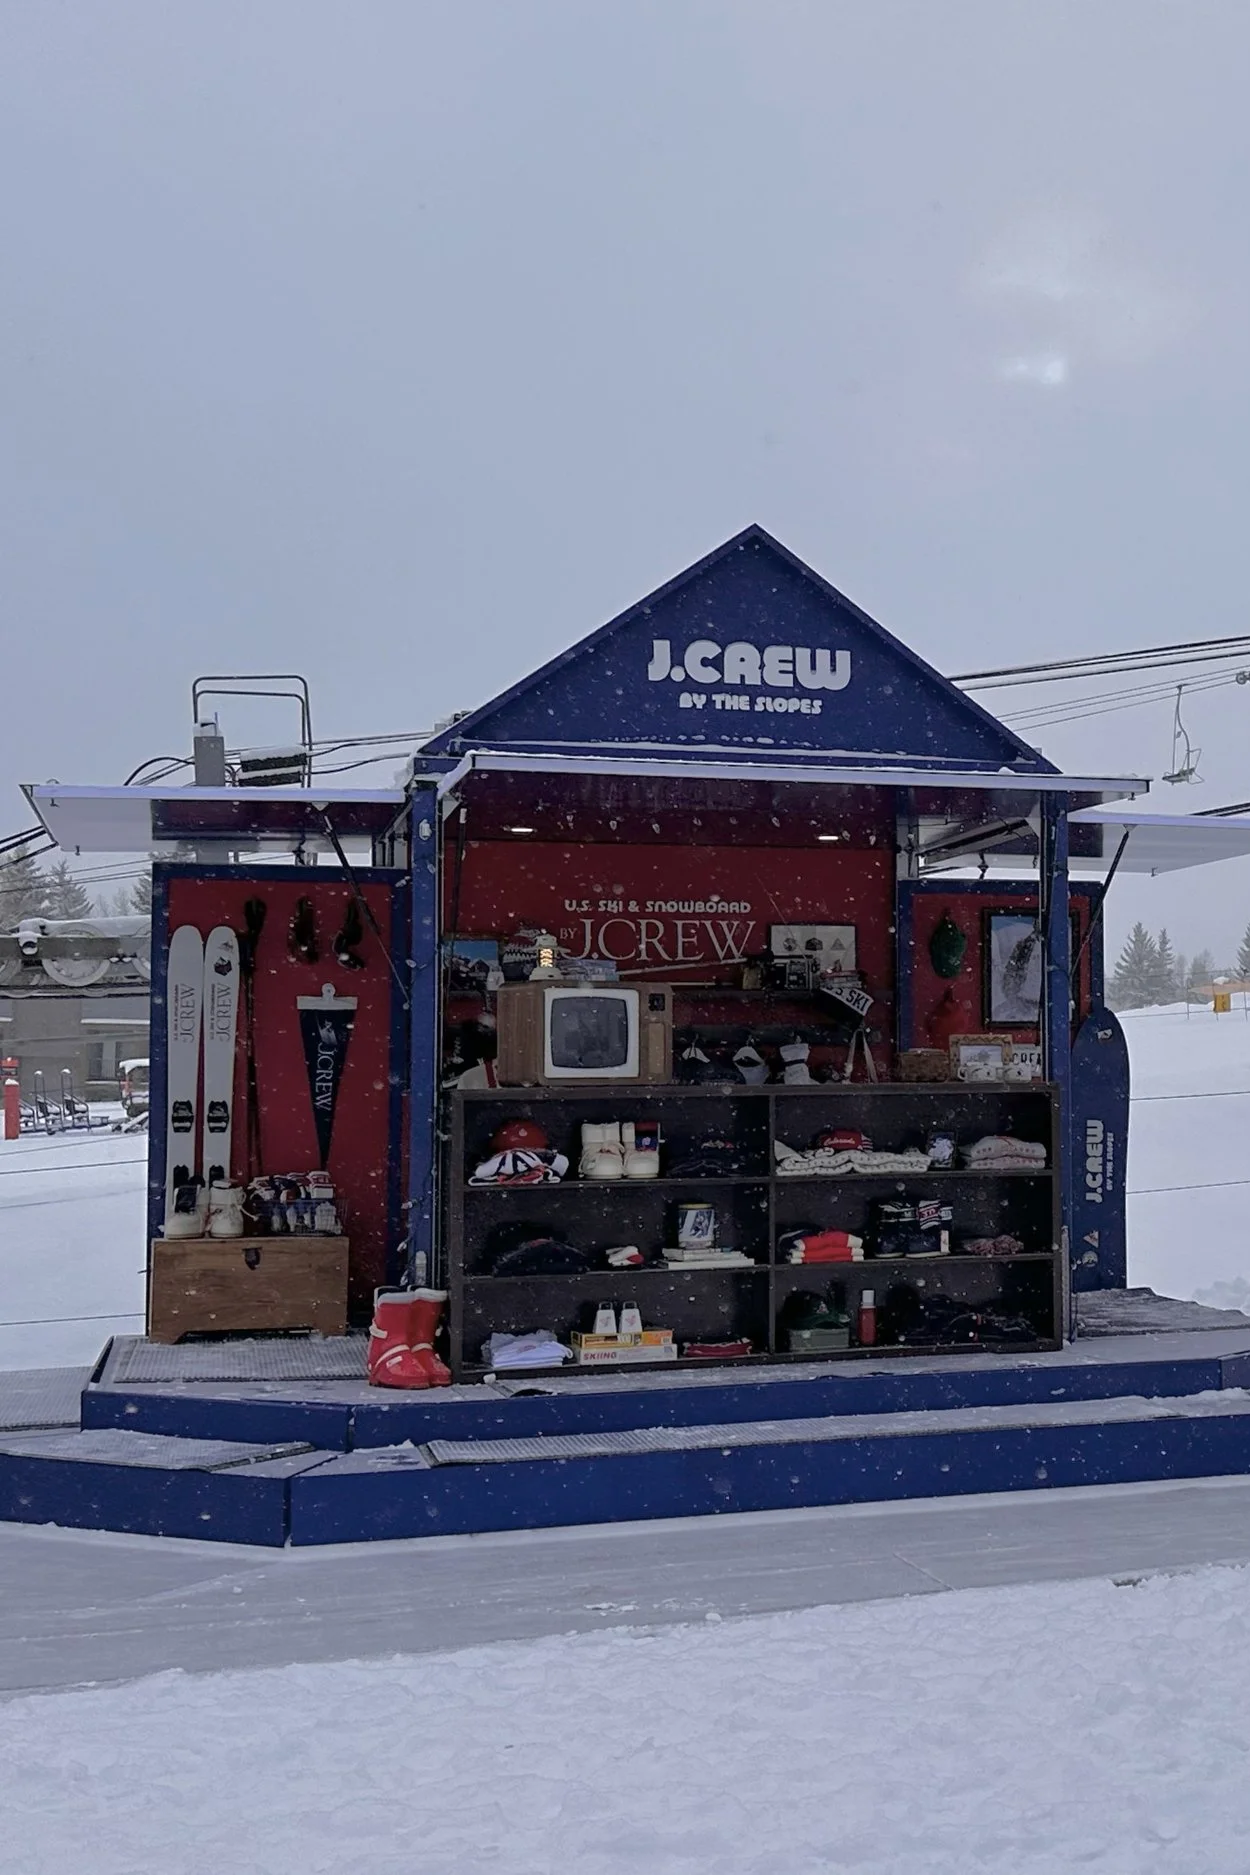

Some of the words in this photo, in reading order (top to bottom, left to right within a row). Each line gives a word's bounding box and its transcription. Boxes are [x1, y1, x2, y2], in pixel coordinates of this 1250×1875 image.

[648, 639, 851, 691] J.CREW
[679, 692, 707, 709] BY
[712, 693, 750, 711] THE
[755, 696, 823, 714] SLOPES
[564, 900, 592, 912] U.S.
[598, 900, 623, 913] SKI
[628, 900, 640, 912] &
[645, 900, 751, 914] SNOWBOARD
[560, 928, 578, 940] BY
[561, 918, 756, 961] J.CREW
[846, 989, 871, 1012] SKI
[313, 1042, 338, 1111] J.CREW
[1085, 1119, 1104, 1203] J.CREW
